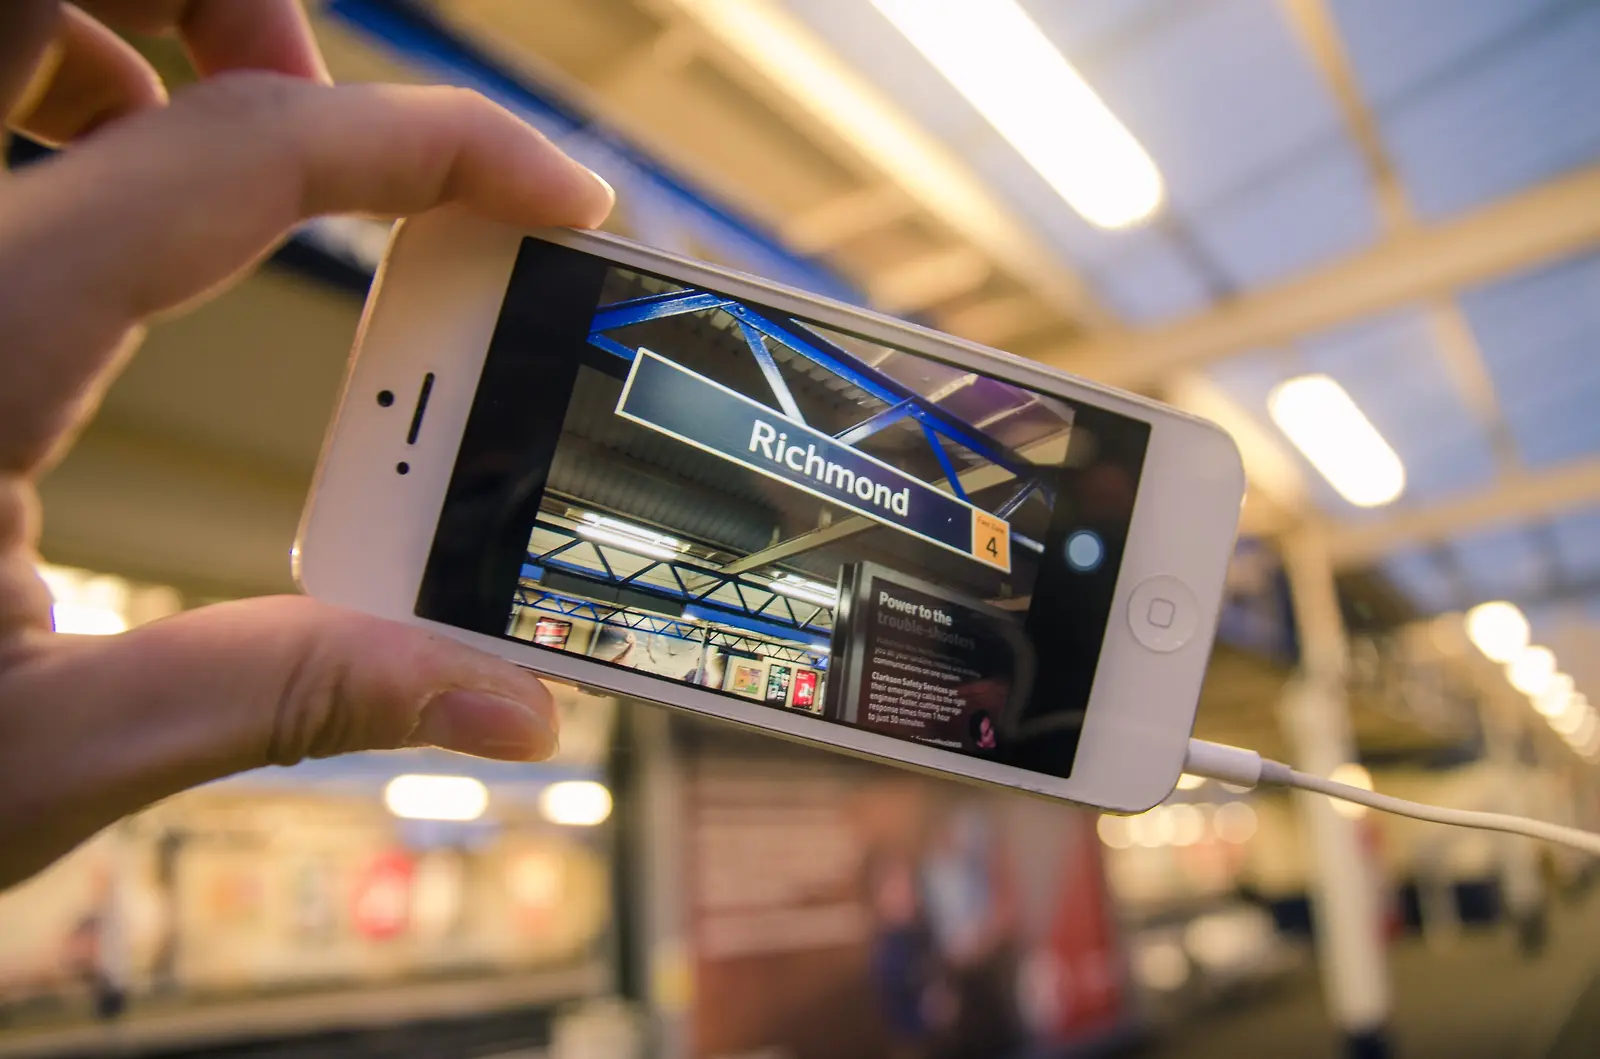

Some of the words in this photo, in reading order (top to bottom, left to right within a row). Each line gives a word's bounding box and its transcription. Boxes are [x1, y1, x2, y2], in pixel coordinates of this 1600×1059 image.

[749, 419, 909, 517] Richmond
[986, 537, 998, 558] 4
[879, 591, 919, 615] Power
[919, 605, 932, 620] to
[932, 609, 953, 626] the
[870, 682, 887, 692] their
[887, 686, 921, 700] emergency
[871, 671, 901, 683] Clarkson
[902, 677, 922, 690] Safety
[923, 682, 948, 695] Services
[869, 693, 898, 704] engineer
[867, 712, 875, 721] to
[875, 714, 889, 723] just
[868, 703, 899, 715] response
[899, 708, 917, 717] times
[917, 709, 932, 719] from
[937, 713, 950, 722] hour
